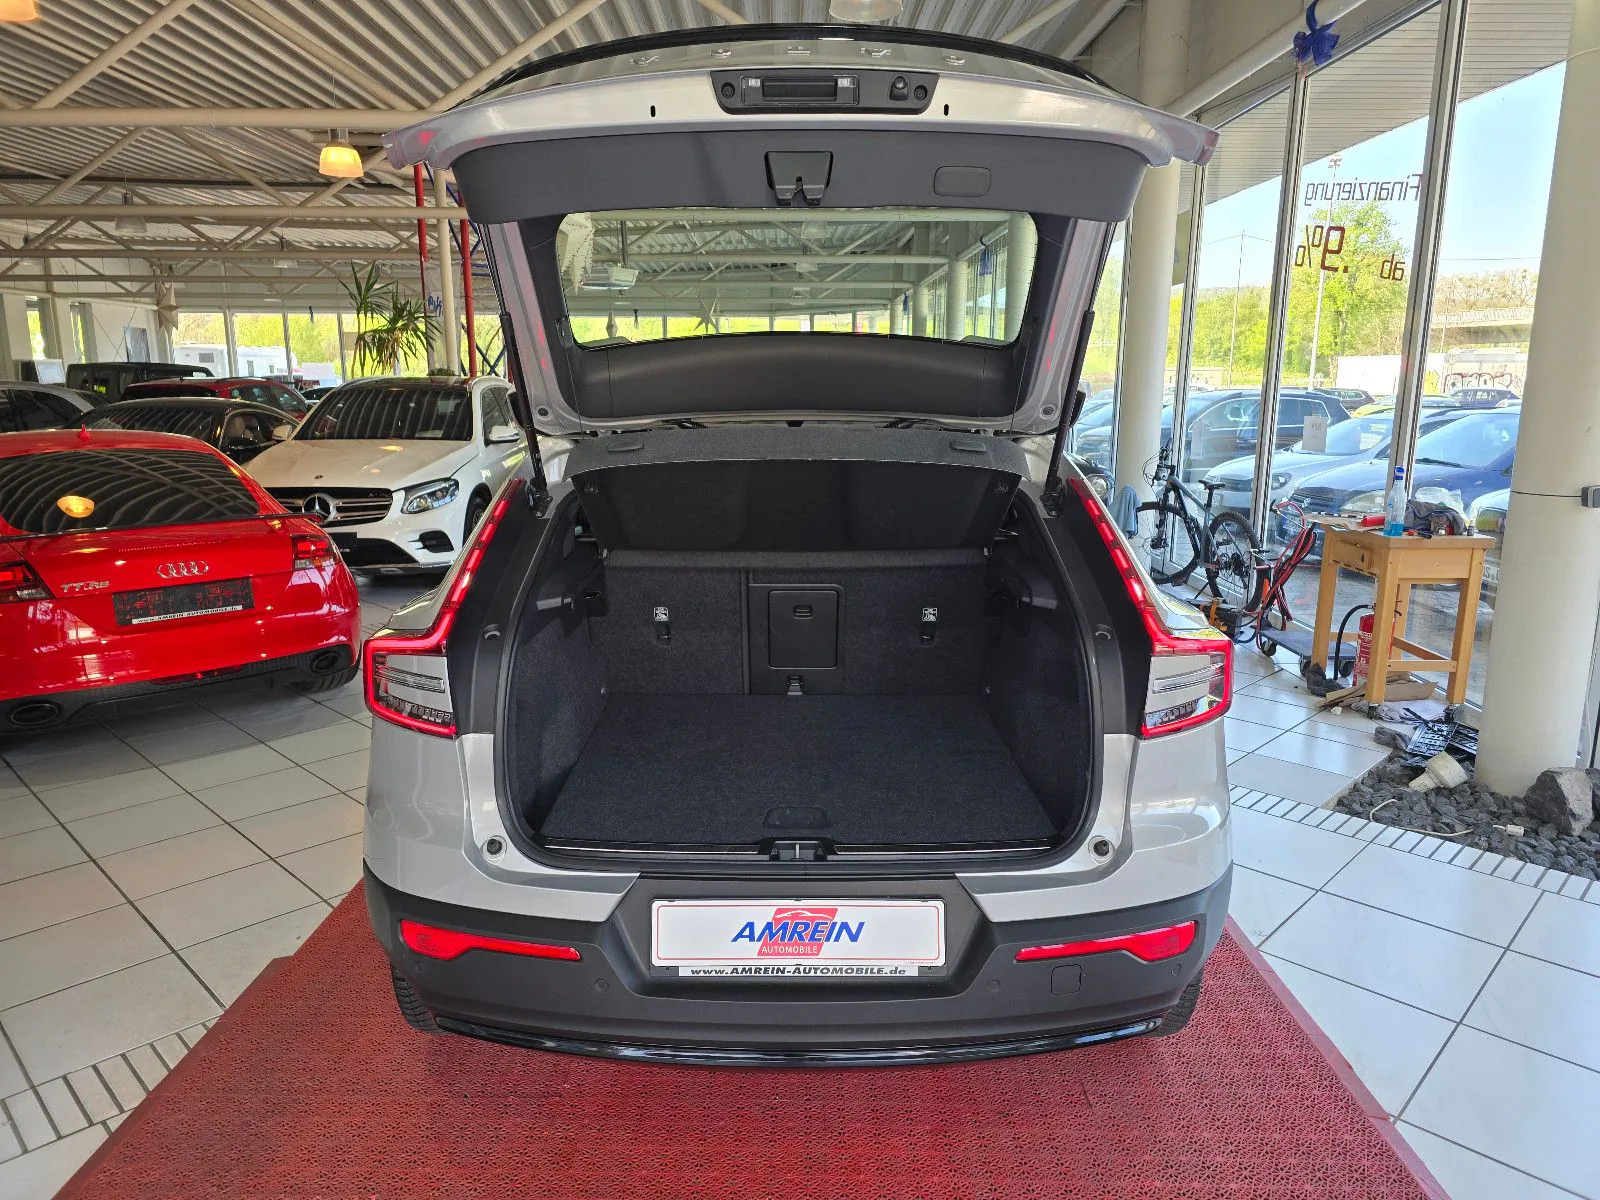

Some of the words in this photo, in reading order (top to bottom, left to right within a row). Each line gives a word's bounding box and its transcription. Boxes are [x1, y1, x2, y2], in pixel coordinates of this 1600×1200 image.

[731, 921, 865, 943] AMREIN
[761, 945, 818, 954] AUTOMOBILE
[690, 966, 906, 976] www.AMREIN-AUTOMOBILE.de
